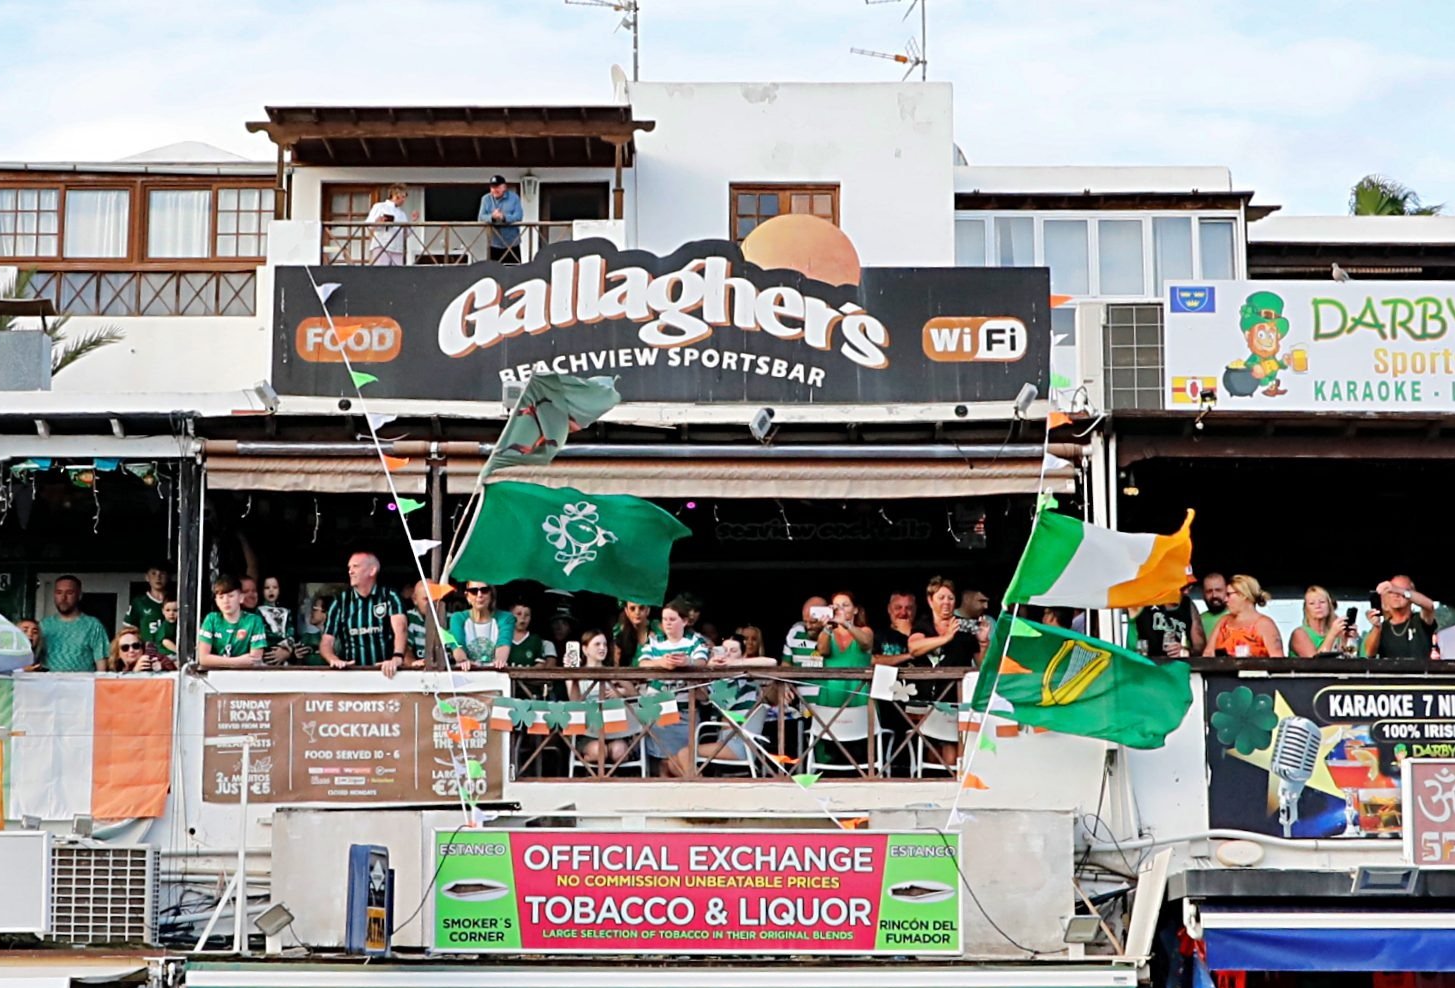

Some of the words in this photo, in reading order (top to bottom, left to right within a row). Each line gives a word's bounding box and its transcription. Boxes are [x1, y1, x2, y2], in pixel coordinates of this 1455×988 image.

[305, 325, 396, 353] FOOD
[499, 346, 658, 386] BEACHVIEW
[668, 347, 827, 389] SPORTSBAR
[1313, 380, 1422, 402] KARAOKE
[229, 700, 271, 709] SUNDAY
[305, 700, 335, 713] LIVE
[338, 700, 385, 713] SPORTS
[1328, 693, 1414, 718] KARAOKE
[1422, 693, 1434, 717] 7
[230, 710, 271, 722] ROAST
[318, 723, 401, 738] COCKTAILS
[1381, 723, 1420, 740] 100%
[433, 739, 453, 749] THE
[1412, 743, 1455, 759] DARBY
[304, 750, 333, 760] FOOD
[335, 750, 372, 760] SERVED
[393, 749, 401, 760] 6
[439, 843, 506, 857] ESTANCO
[890, 845, 958, 858] ESTANCO
[523, 845, 679, 872] OFFICIAL
[689, 845, 874, 873] EXCHANGE
[556, 875, 580, 889] NO
[584, 875, 681, 889] COMMISSION
[684, 875, 785, 889] UNBEATABLE
[788, 875, 840, 889] PRICES
[525, 897, 695, 926] TOBACCO
[705, 897, 729, 926] &
[738, 896, 873, 928] LIQUOR
[879, 916, 927, 932] RINCÓN
[930, 919, 958, 932] DEL
[449, 929, 505, 943] CORNER
[542, 929, 578, 940] LARGE
[580, 929, 640, 940] SELECTION
[641, 929, 657, 940] OF
[658, 929, 709, 940] TOBACCO
[712, 929, 723, 941] IN
[726, 929, 757, 941] THEIR
[759, 929, 810, 941] ORIGINAL
[812, 929, 854, 941] BLENDS
[885, 931, 952, 945] FUMADOR
